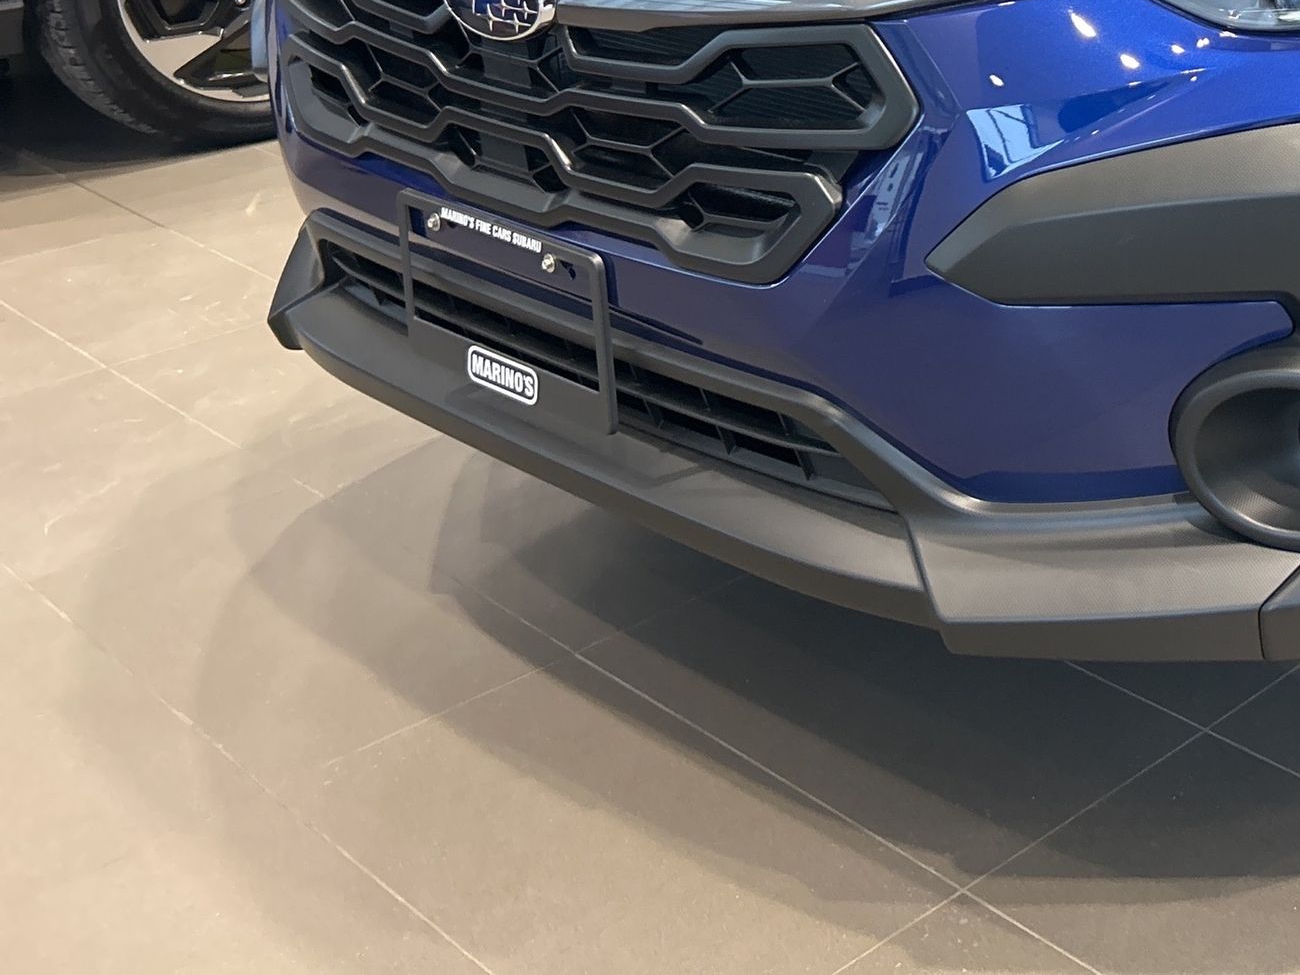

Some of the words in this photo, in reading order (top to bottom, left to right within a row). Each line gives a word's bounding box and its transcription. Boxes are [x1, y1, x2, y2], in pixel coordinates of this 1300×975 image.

[440, 207, 475, 229] MARINO'S
[475, 218, 492, 235] FINE
[492, 224, 512, 243] CARS
[512, 232, 542, 253] SUBARU
[472, 353, 534, 397] MARINO'S
